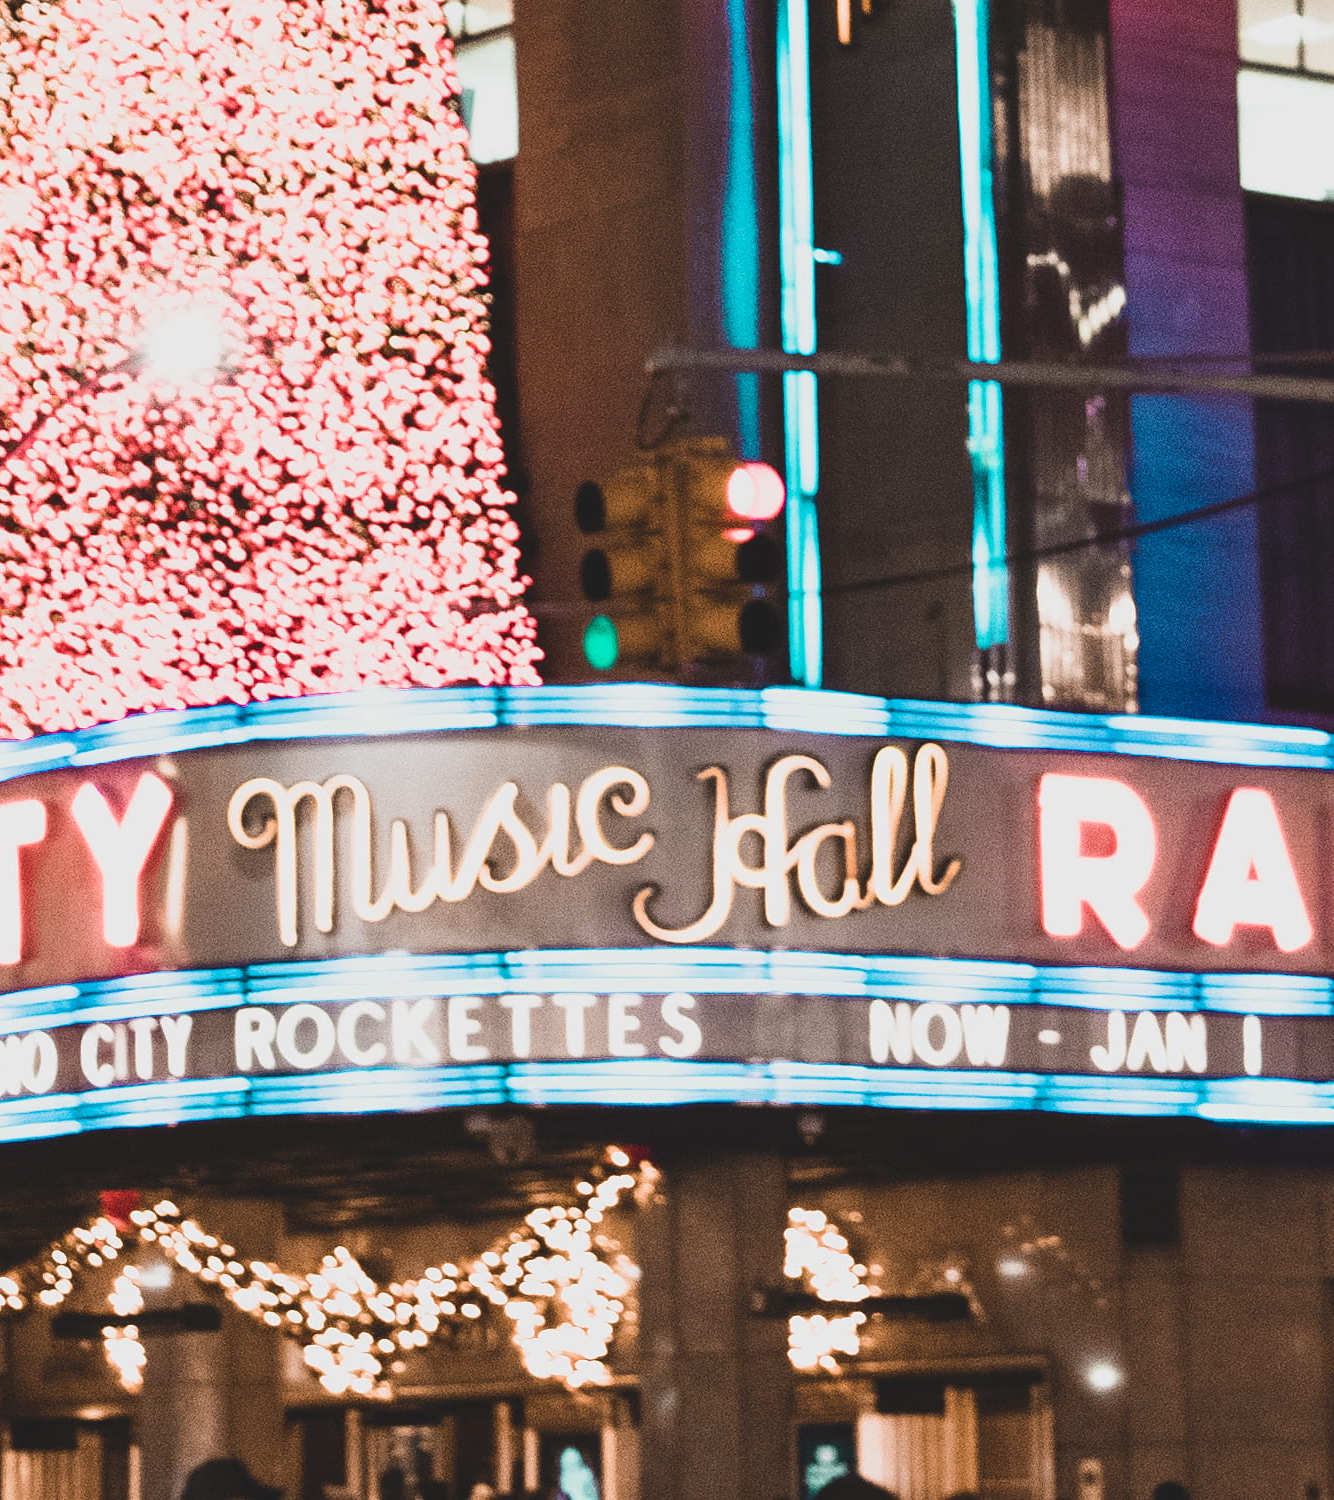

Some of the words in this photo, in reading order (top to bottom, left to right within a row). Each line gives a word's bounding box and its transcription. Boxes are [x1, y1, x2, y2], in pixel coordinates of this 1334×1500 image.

[227, 764, 657, 948] Music
[633, 741, 962, 945] Hall
[80, 1013, 195, 1089] CITY
[234, 992, 702, 1073] ROCKETTES
[869, 999, 1011, 1067] NOW
[1090, 1010, 1208, 1073] JAN
